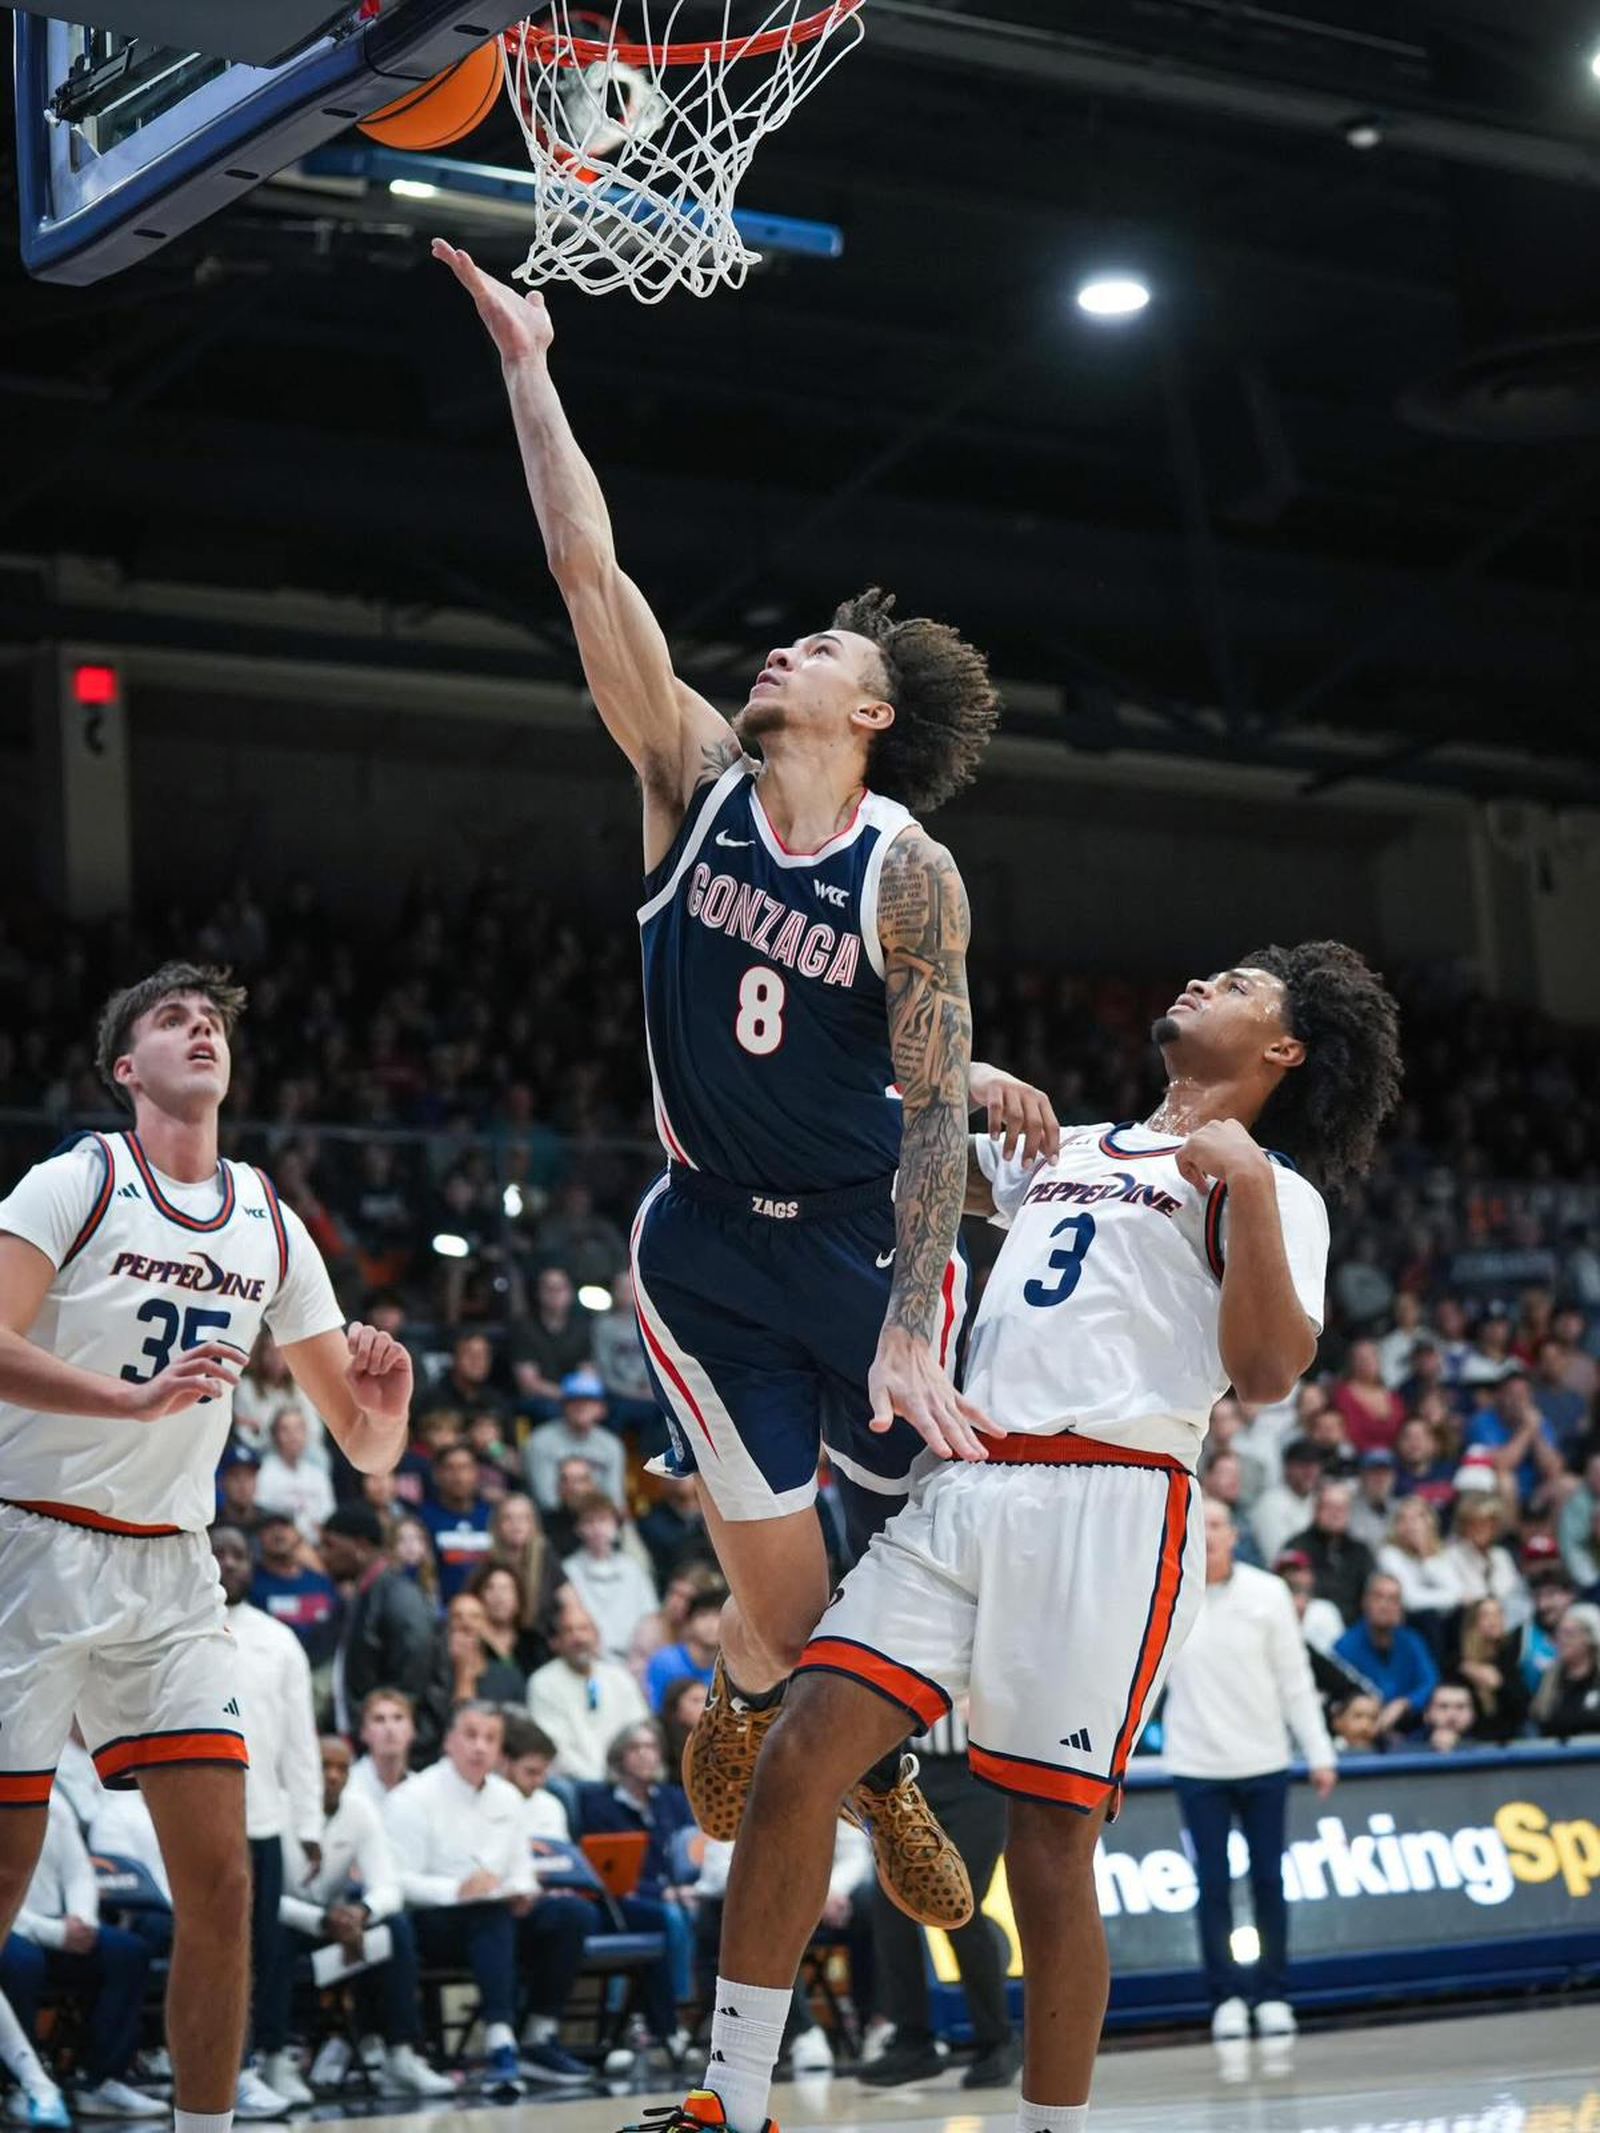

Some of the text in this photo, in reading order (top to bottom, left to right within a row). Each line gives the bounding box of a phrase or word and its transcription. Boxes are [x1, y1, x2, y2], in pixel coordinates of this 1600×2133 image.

[813, 879, 850, 908] WCC
[688, 862, 861, 988] GONZAGA
[735, 965, 786, 1056] 8
[752, 1196, 799, 1219] ZAGS
[1023, 1172, 1183, 1218] PEPPERDINE
[109, 1251, 266, 1302] PEPPERDINE
[1023, 1212, 1096, 1307] 3
